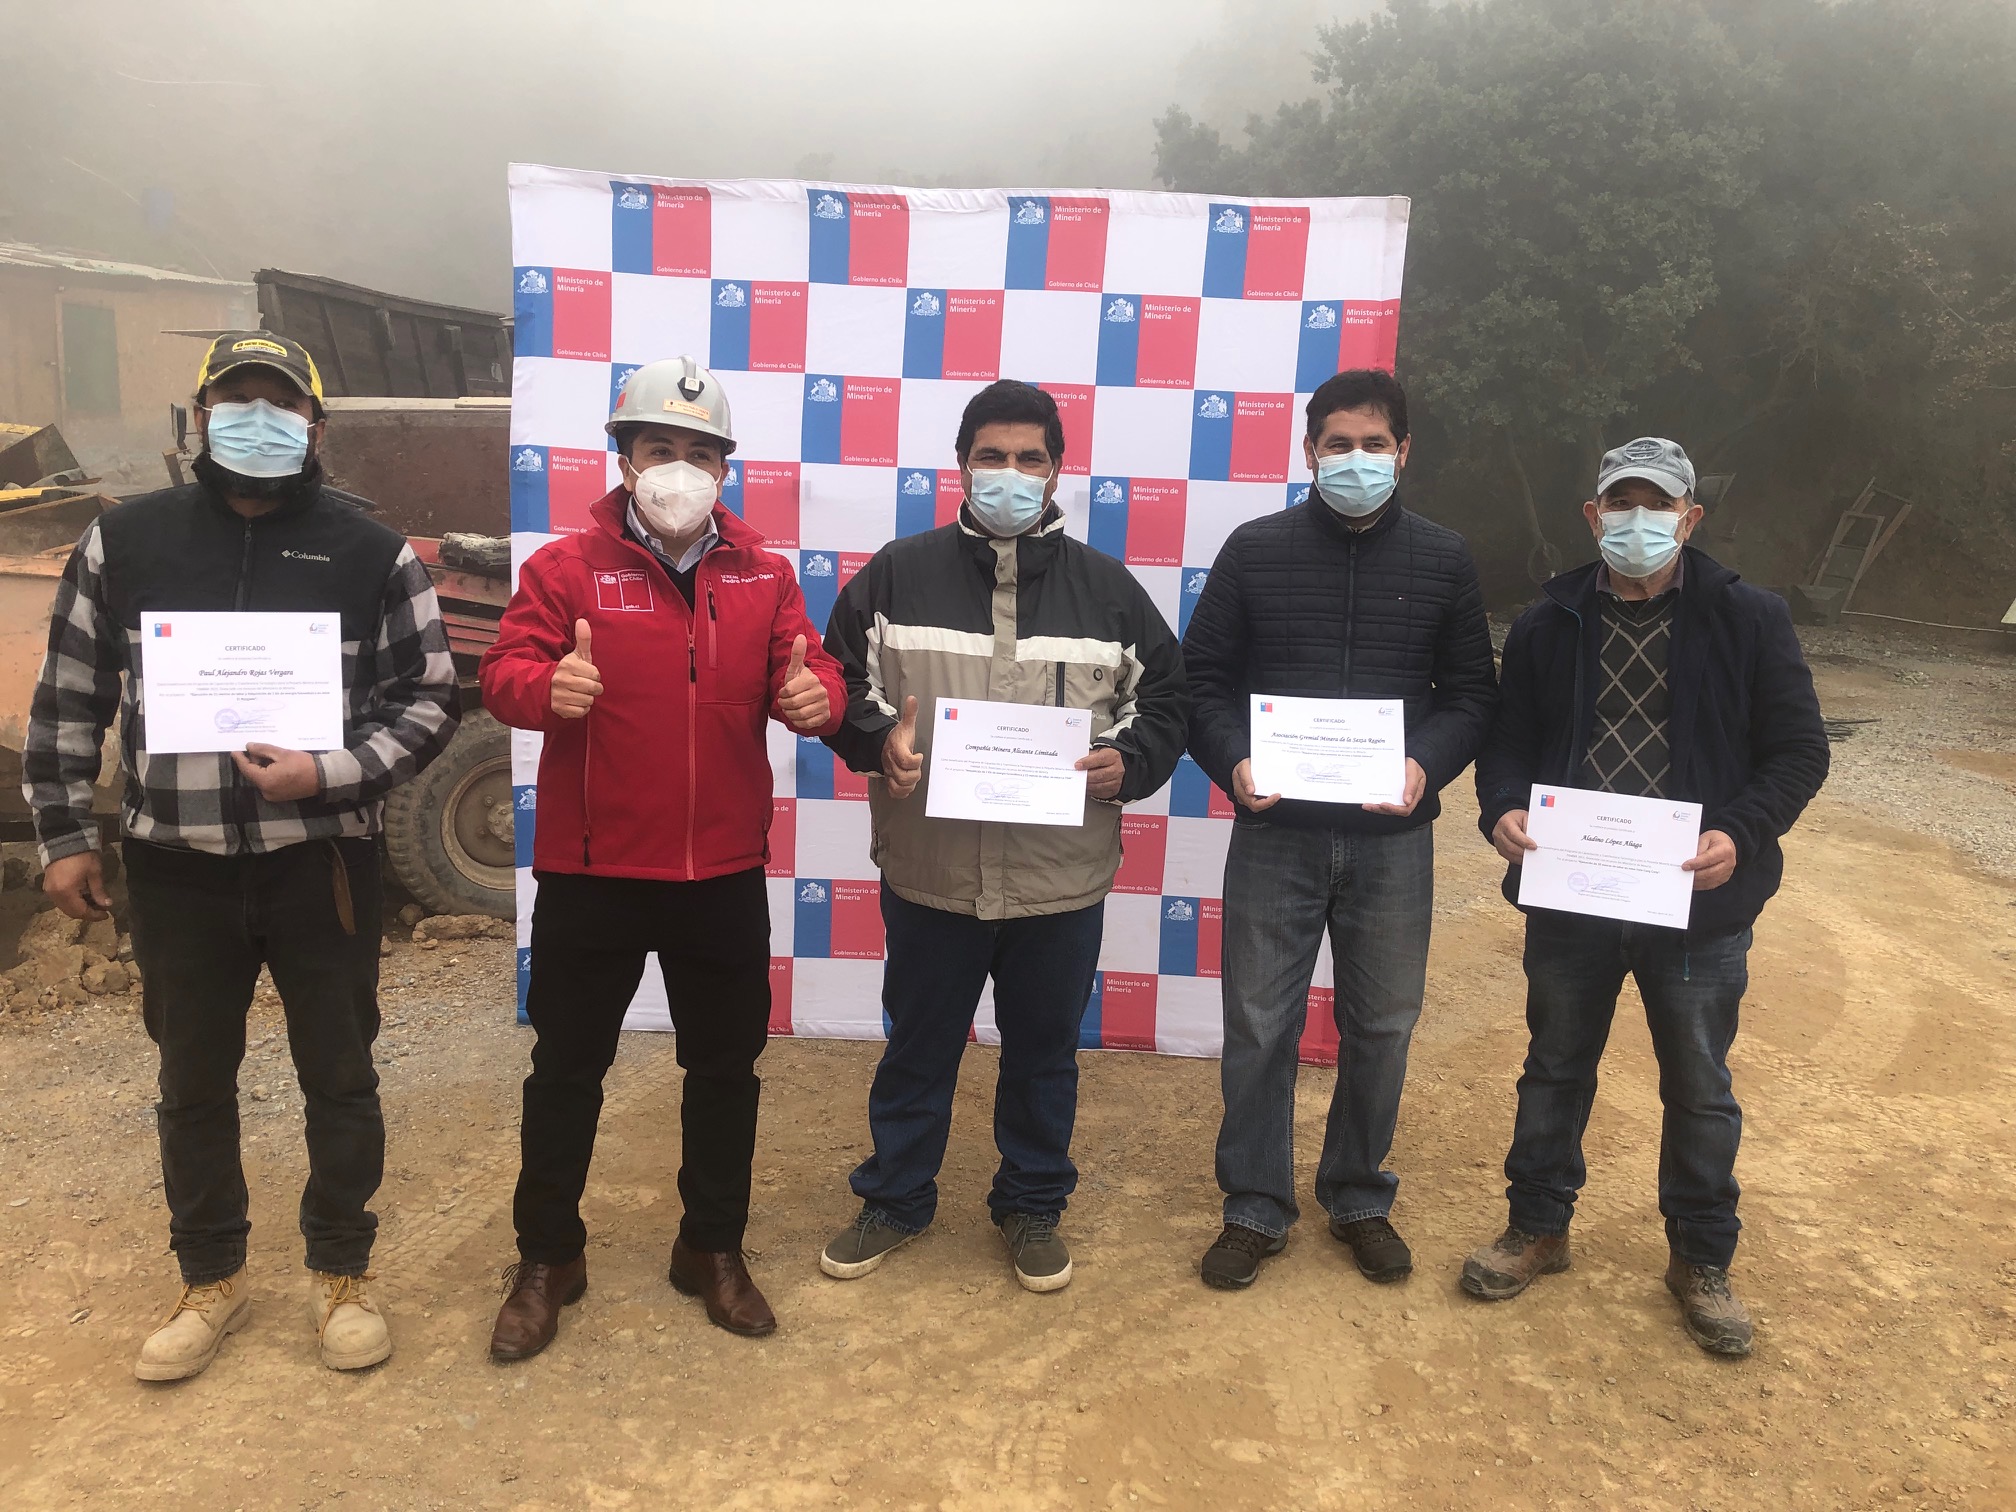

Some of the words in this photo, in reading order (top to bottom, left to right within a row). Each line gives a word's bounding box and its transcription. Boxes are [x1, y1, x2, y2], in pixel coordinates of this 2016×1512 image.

[557, 276, 594, 285] Ministerio
[557, 284, 585, 292] Minería
[553, 456, 587, 464] Ministerio
[553, 463, 580, 471] Minería
[940, 477, 961, 485] Minis
[291, 550, 331, 562] Columbia
[841, 559, 868, 567] Ministe
[740, 576, 758, 584] Pablo
[215, 669, 247, 677] Alejandro
[269, 669, 293, 677] Vergara
[1597, 816, 1631, 824] CERTIFICADO
[1605, 838, 1622, 846] López
